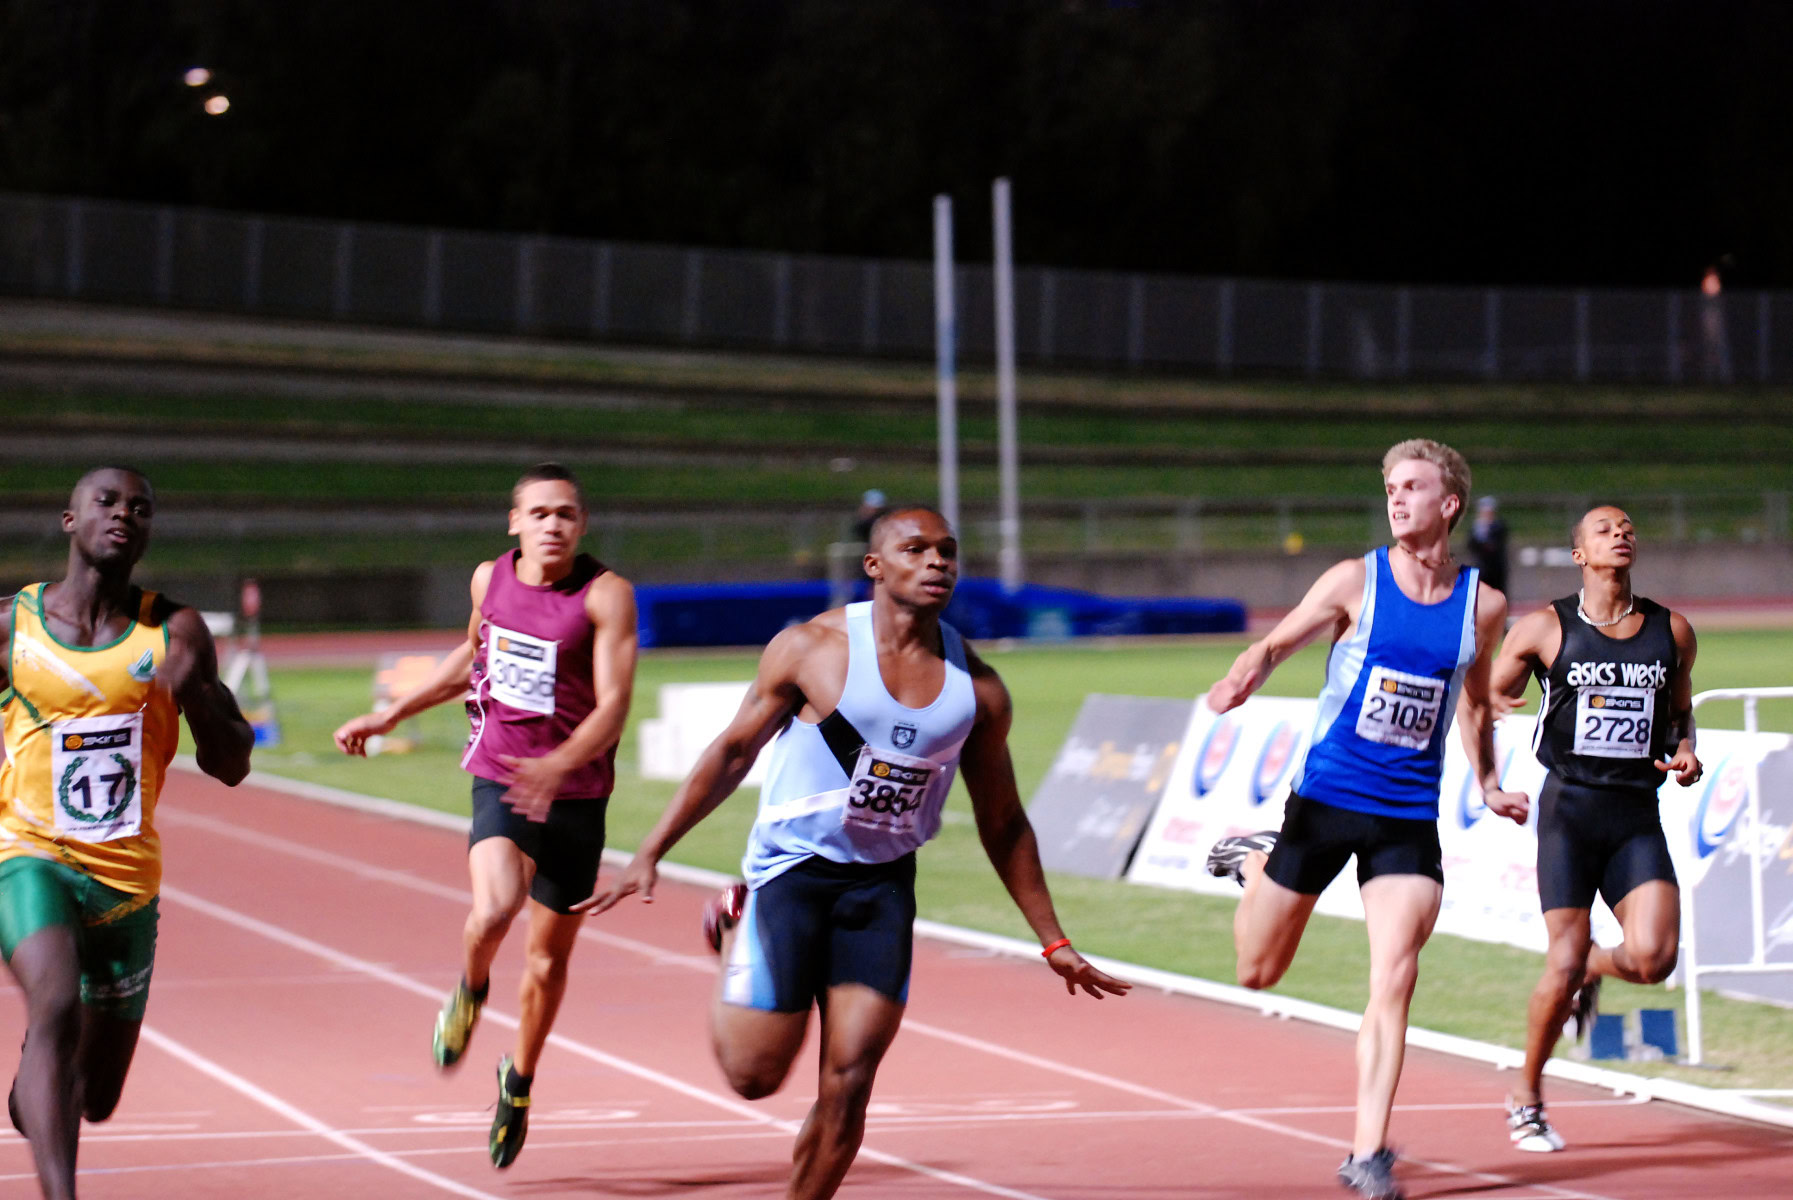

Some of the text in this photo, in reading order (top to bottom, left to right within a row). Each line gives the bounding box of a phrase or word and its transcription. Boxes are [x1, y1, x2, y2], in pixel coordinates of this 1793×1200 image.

[494, 659, 555, 697] 3056
[1567, 660, 1666, 690] asics wests
[1366, 697, 1435, 732] 2105
[1584, 716, 1650, 744] 2728
[72, 773, 125, 809] 17
